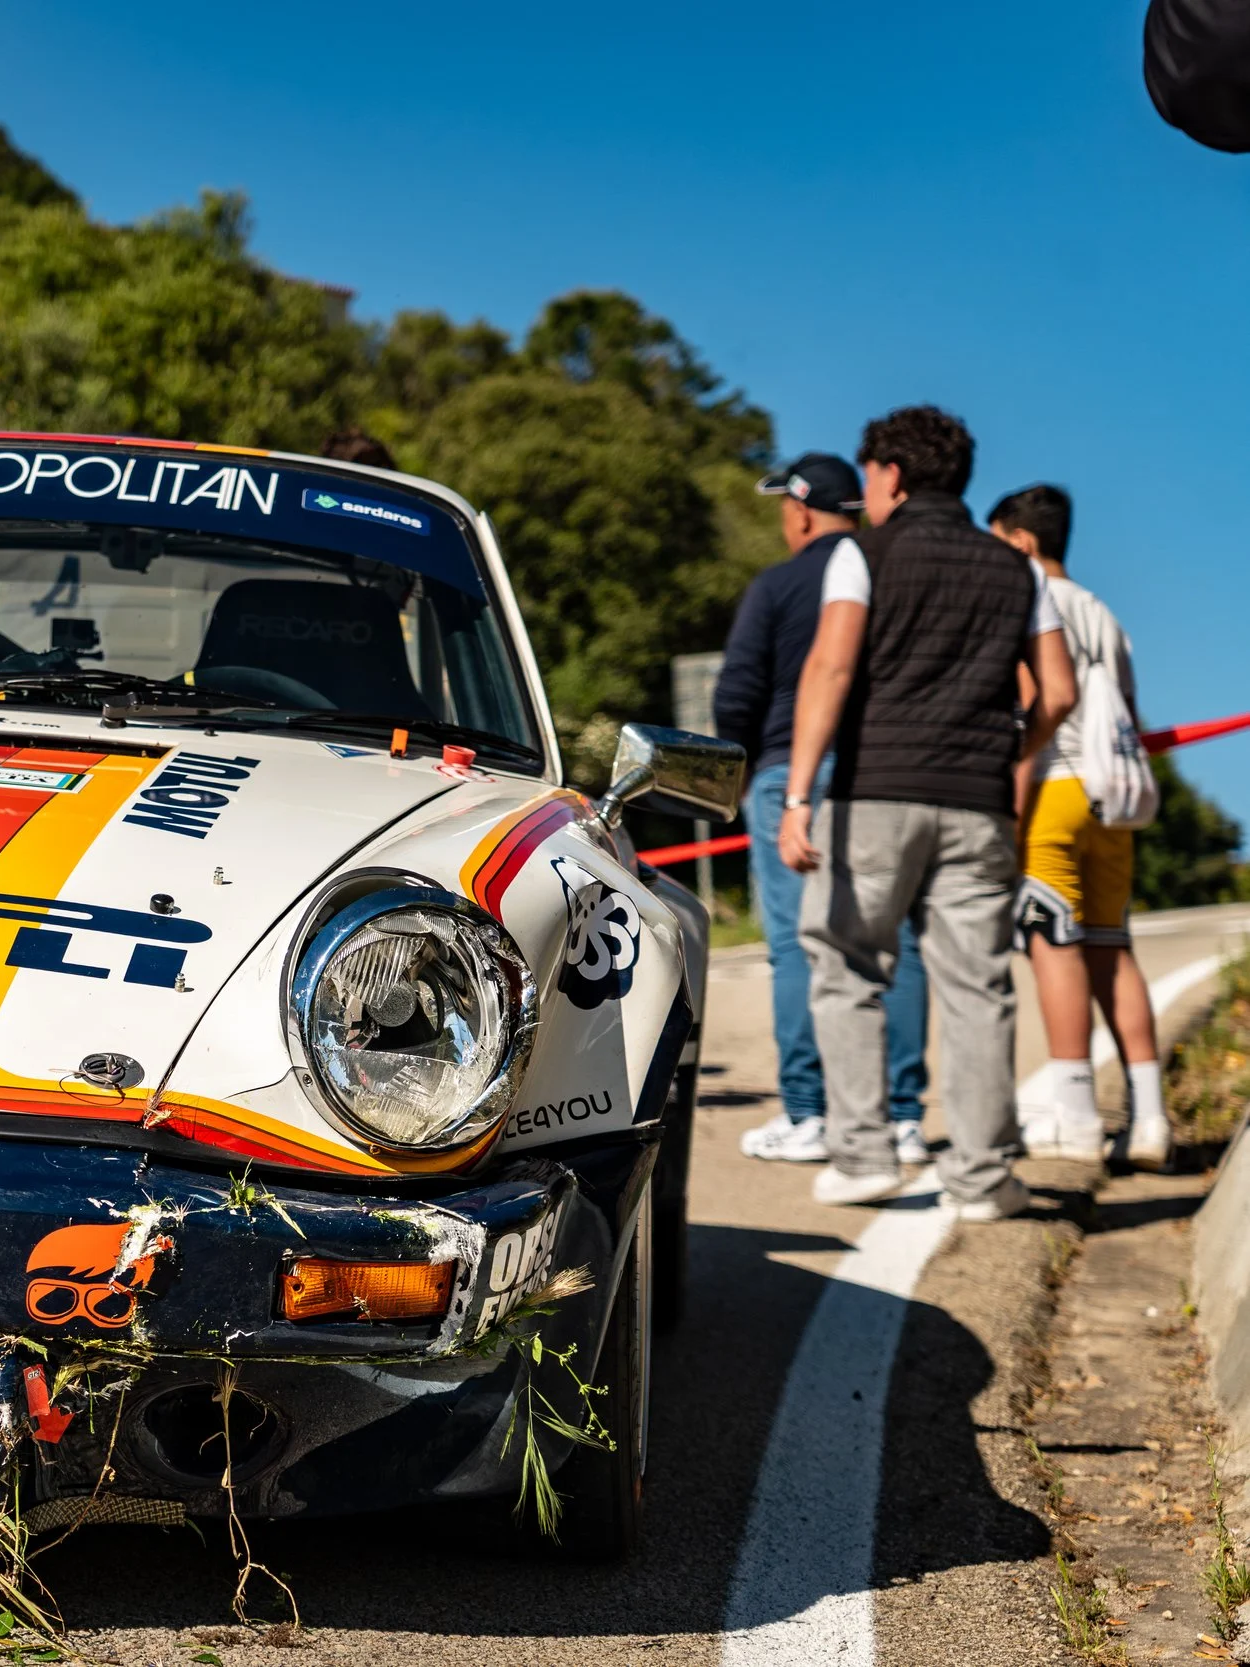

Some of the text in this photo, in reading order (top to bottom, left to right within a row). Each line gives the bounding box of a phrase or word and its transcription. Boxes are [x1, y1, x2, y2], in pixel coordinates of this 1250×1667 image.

[342, 501, 422, 528] sardares
[236, 613, 373, 645] RECARO
[122, 752, 261, 840] MOTUL
[502, 1090, 612, 1140] CE4YOU
